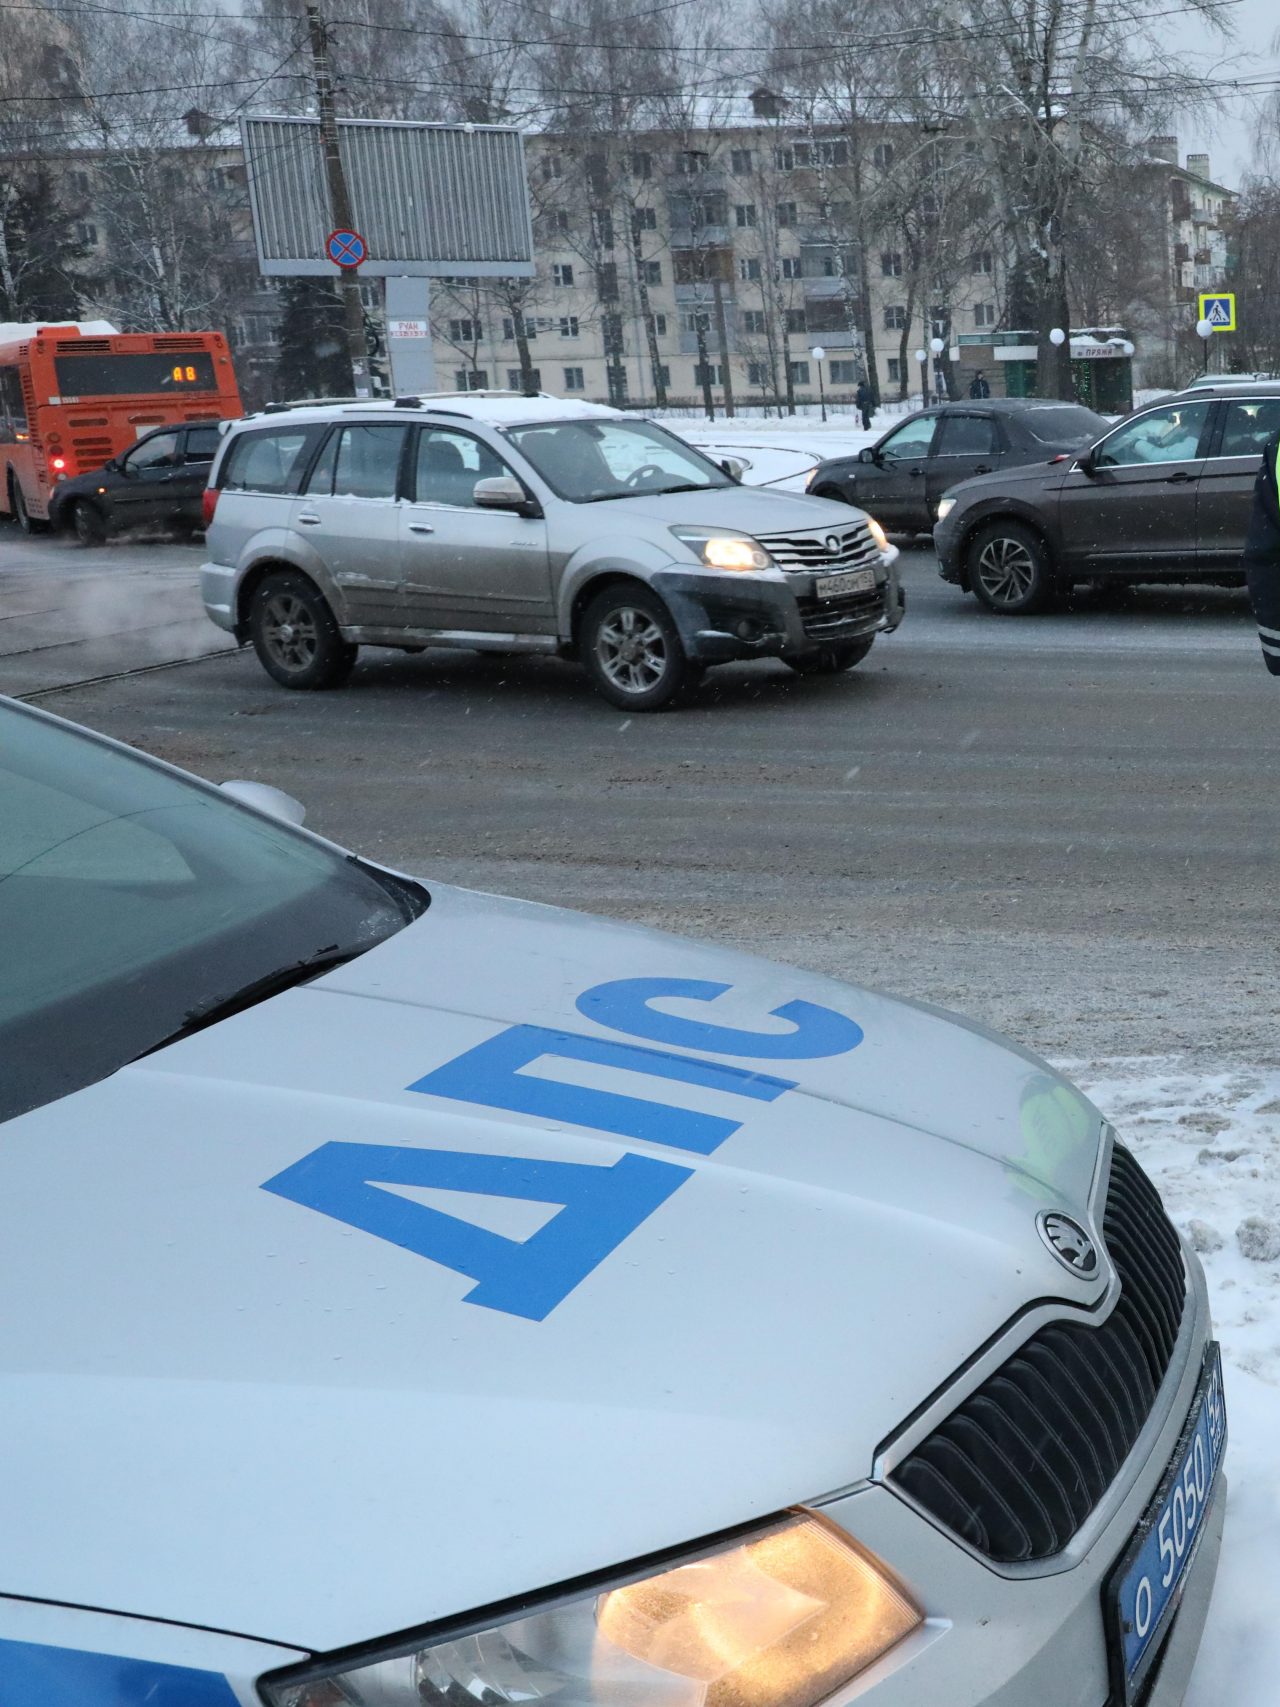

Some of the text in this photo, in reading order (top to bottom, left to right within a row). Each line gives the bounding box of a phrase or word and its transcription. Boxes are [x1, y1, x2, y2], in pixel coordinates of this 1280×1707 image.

[259, 977, 865, 1322] ДПС
[1158, 1433, 1205, 1588] 5050
[1207, 1368, 1220, 1438] 52
